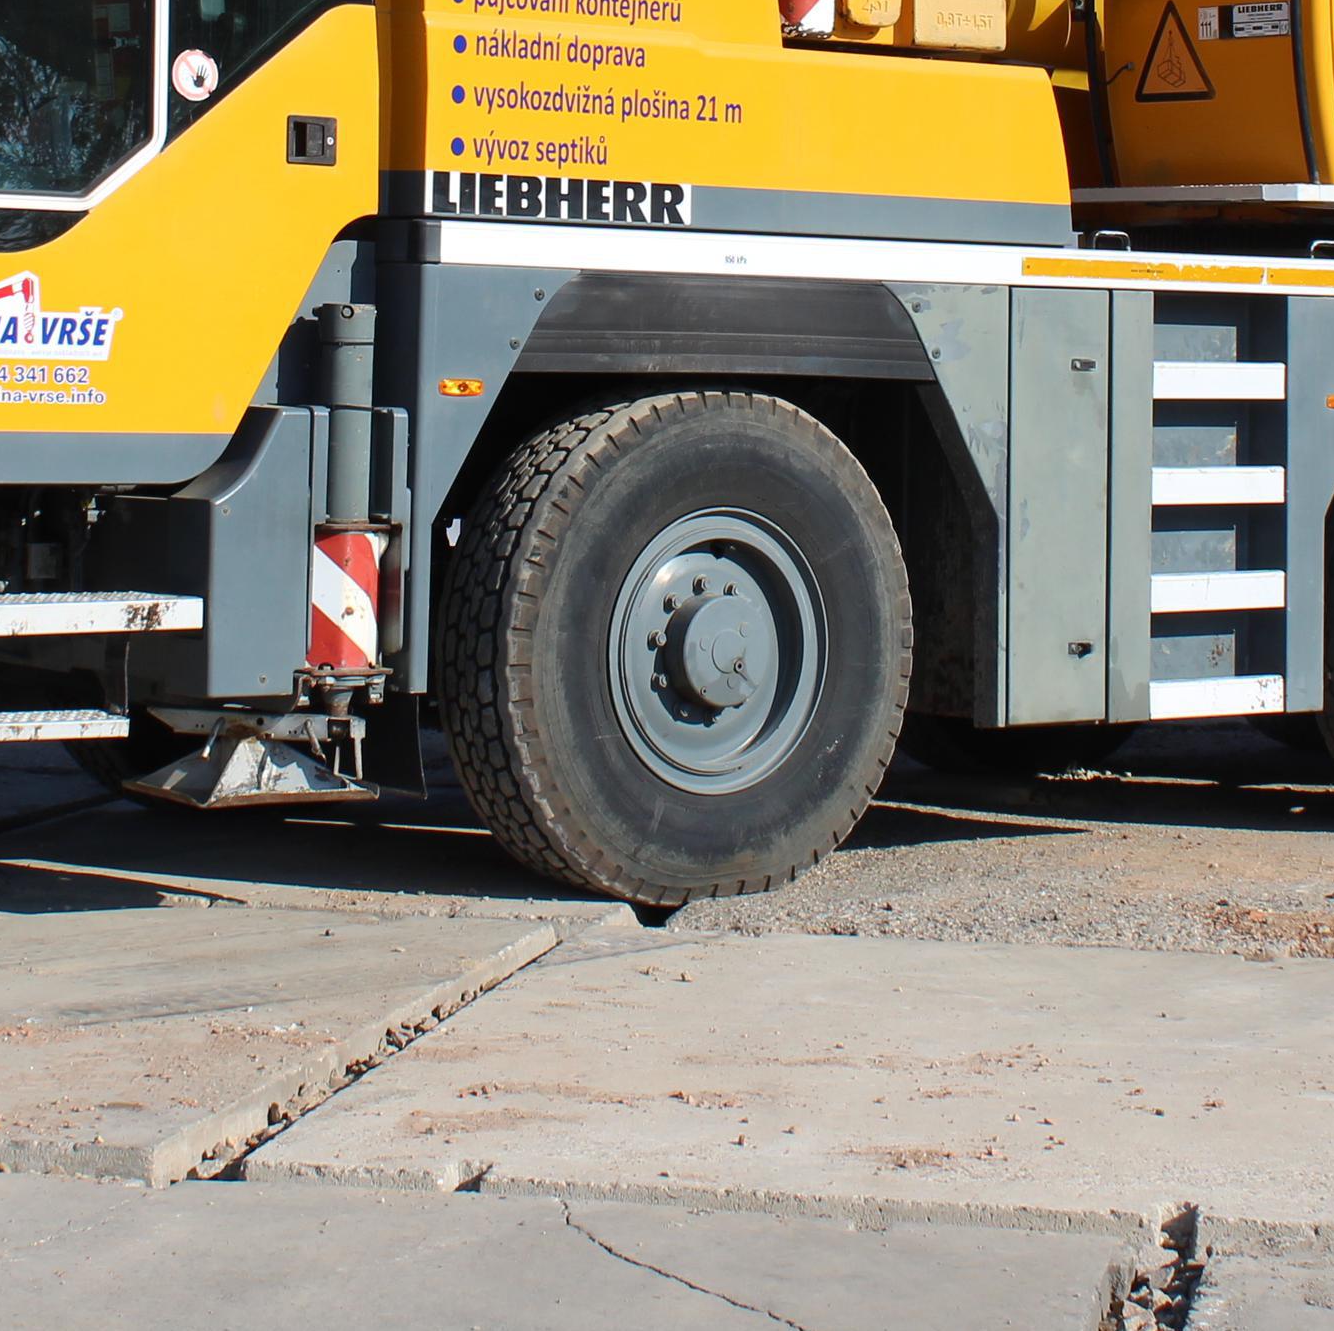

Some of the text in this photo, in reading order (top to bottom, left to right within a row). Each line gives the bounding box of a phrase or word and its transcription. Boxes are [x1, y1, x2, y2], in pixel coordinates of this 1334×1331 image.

[1238, 4, 1283, 14] LIEBHERR
[475, 28, 645, 71] nákladní doprava
[473, 81, 742, 123] vysokozdvižná plošina 21 m
[473, 130, 607, 169] vývoz septiků
[430, 170, 685, 225] LIEBHERR
[41, 311, 110, 346] VRŠE
[14, 367, 47, 382] 341
[54, 368, 88, 383] 662
